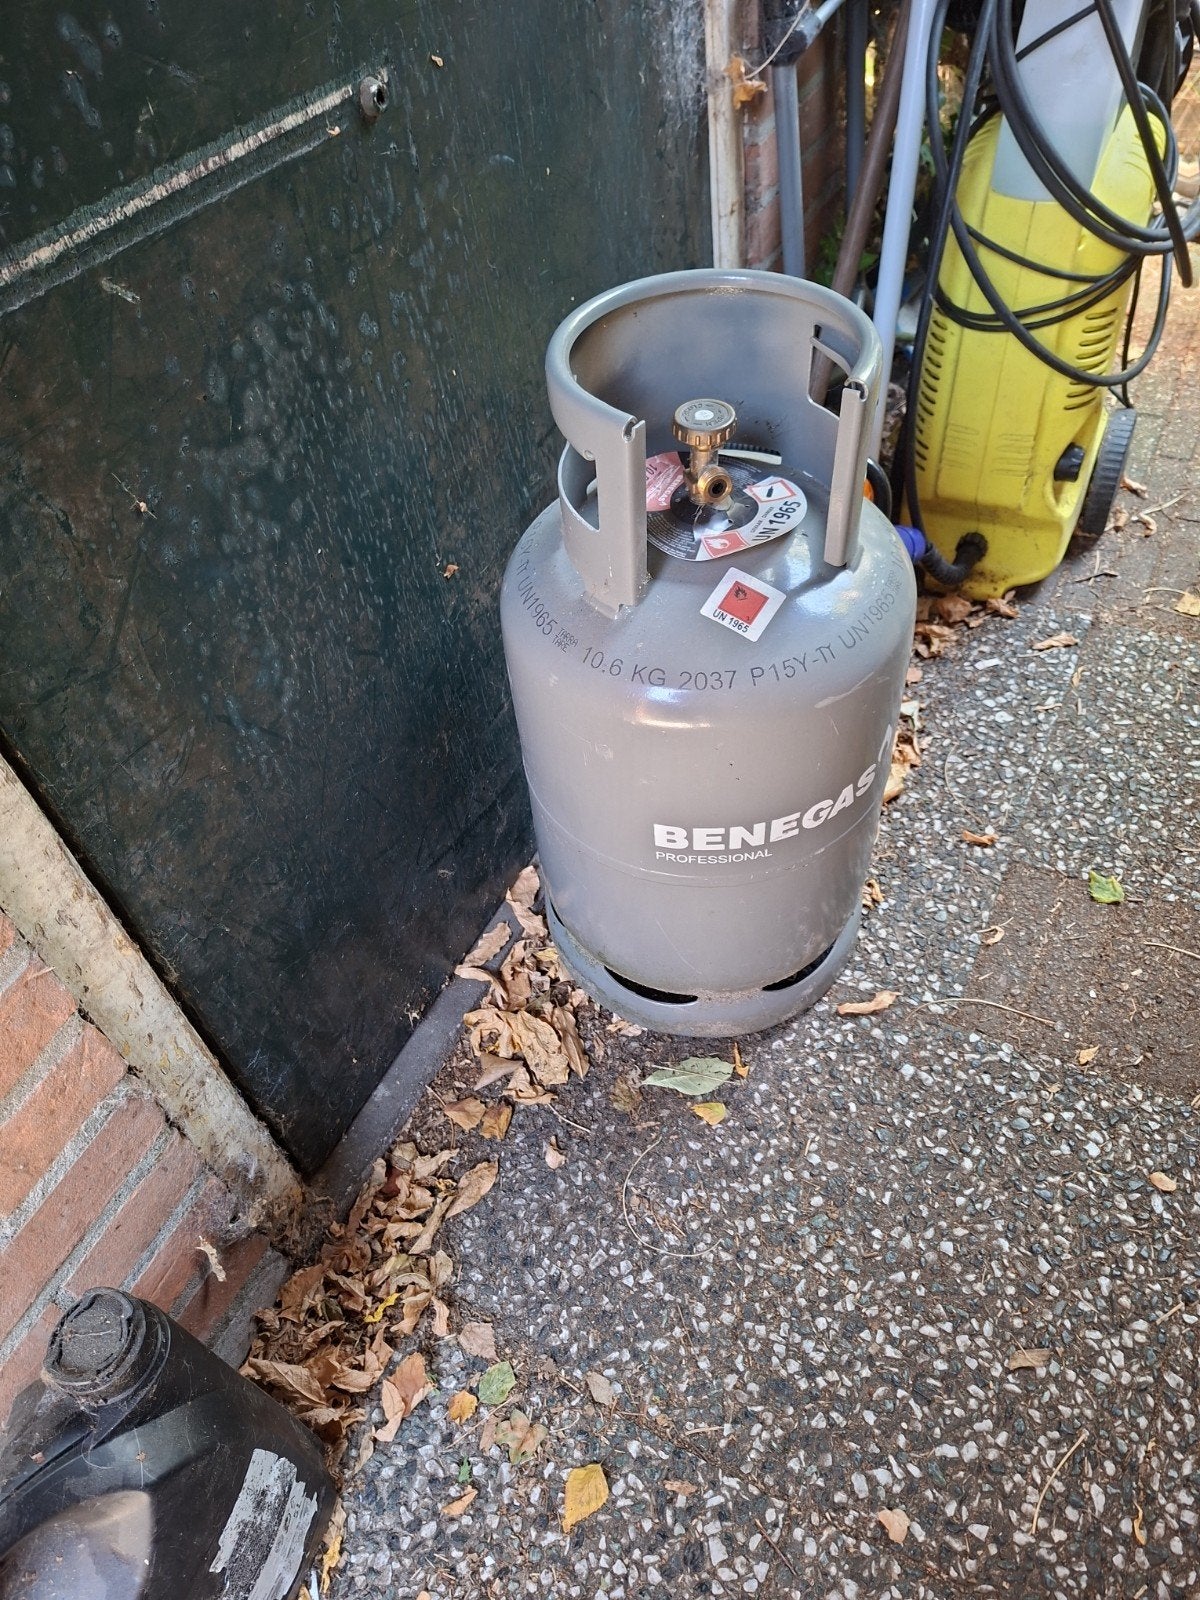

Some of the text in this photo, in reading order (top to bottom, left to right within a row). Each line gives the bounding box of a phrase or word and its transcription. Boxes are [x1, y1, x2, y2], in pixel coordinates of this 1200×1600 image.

[751, 500, 801, 541] UN 1965
[517, 576, 558, 636] UN1965
[712, 608, 750, 633] UN 1965
[552, 634, 570, 653] TARE
[557, 627, 579, 648] TARRA
[582, 646, 624, 677] 10.6
[631, 663, 666, 686] KG
[678, 669, 737, 691] 2037
[838, 588, 895, 649] UN1965
[653, 763, 877, 850] BENEGAS
[655, 848, 773, 864] PROFESSIONAL
